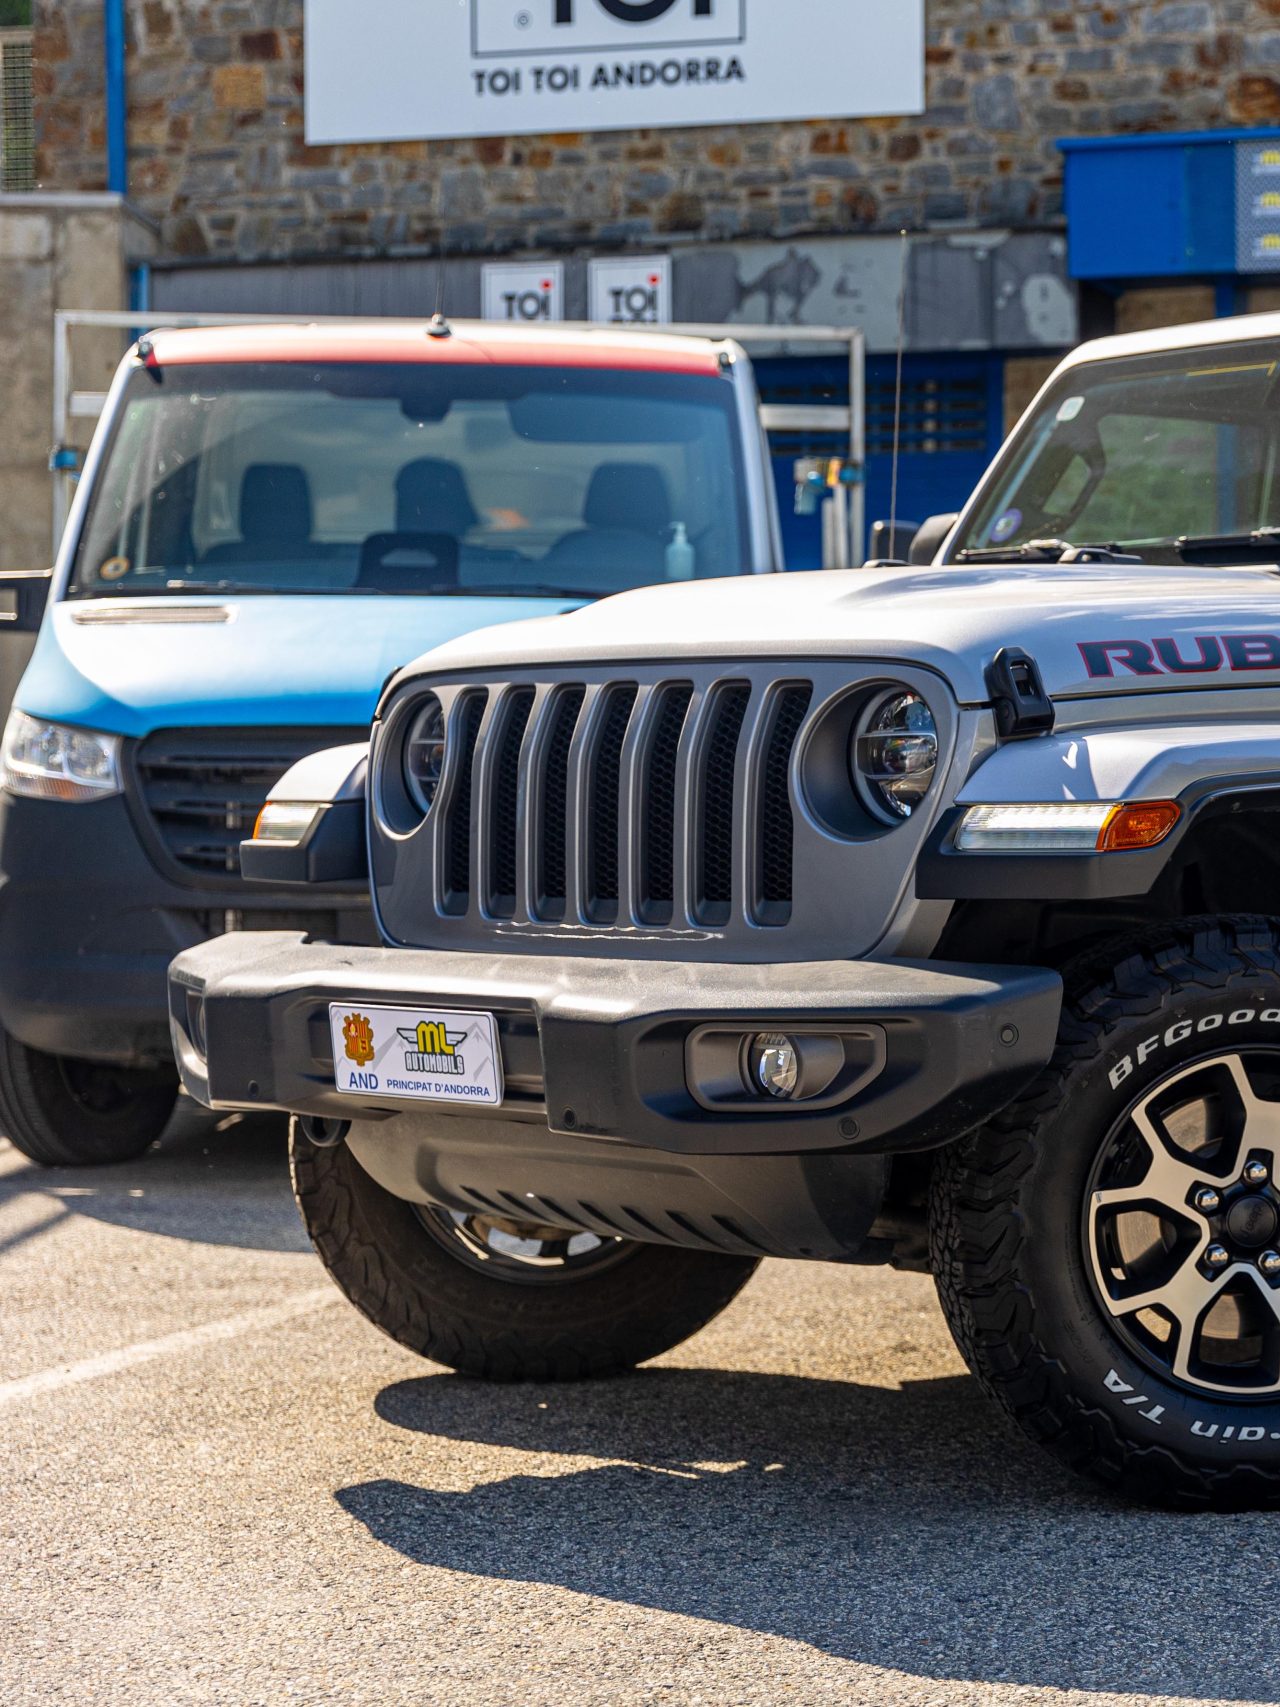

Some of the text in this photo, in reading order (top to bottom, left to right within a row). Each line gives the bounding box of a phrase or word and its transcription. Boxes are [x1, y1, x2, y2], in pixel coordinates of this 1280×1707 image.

[473, 56, 745, 96] TOI TOI ANDORRA
[416, 1020, 456, 1055] ML
[349, 1072, 491, 1097] AND PRINCIPAT D'ANDORRA
[1103, 1368, 1167, 1425] T/A
